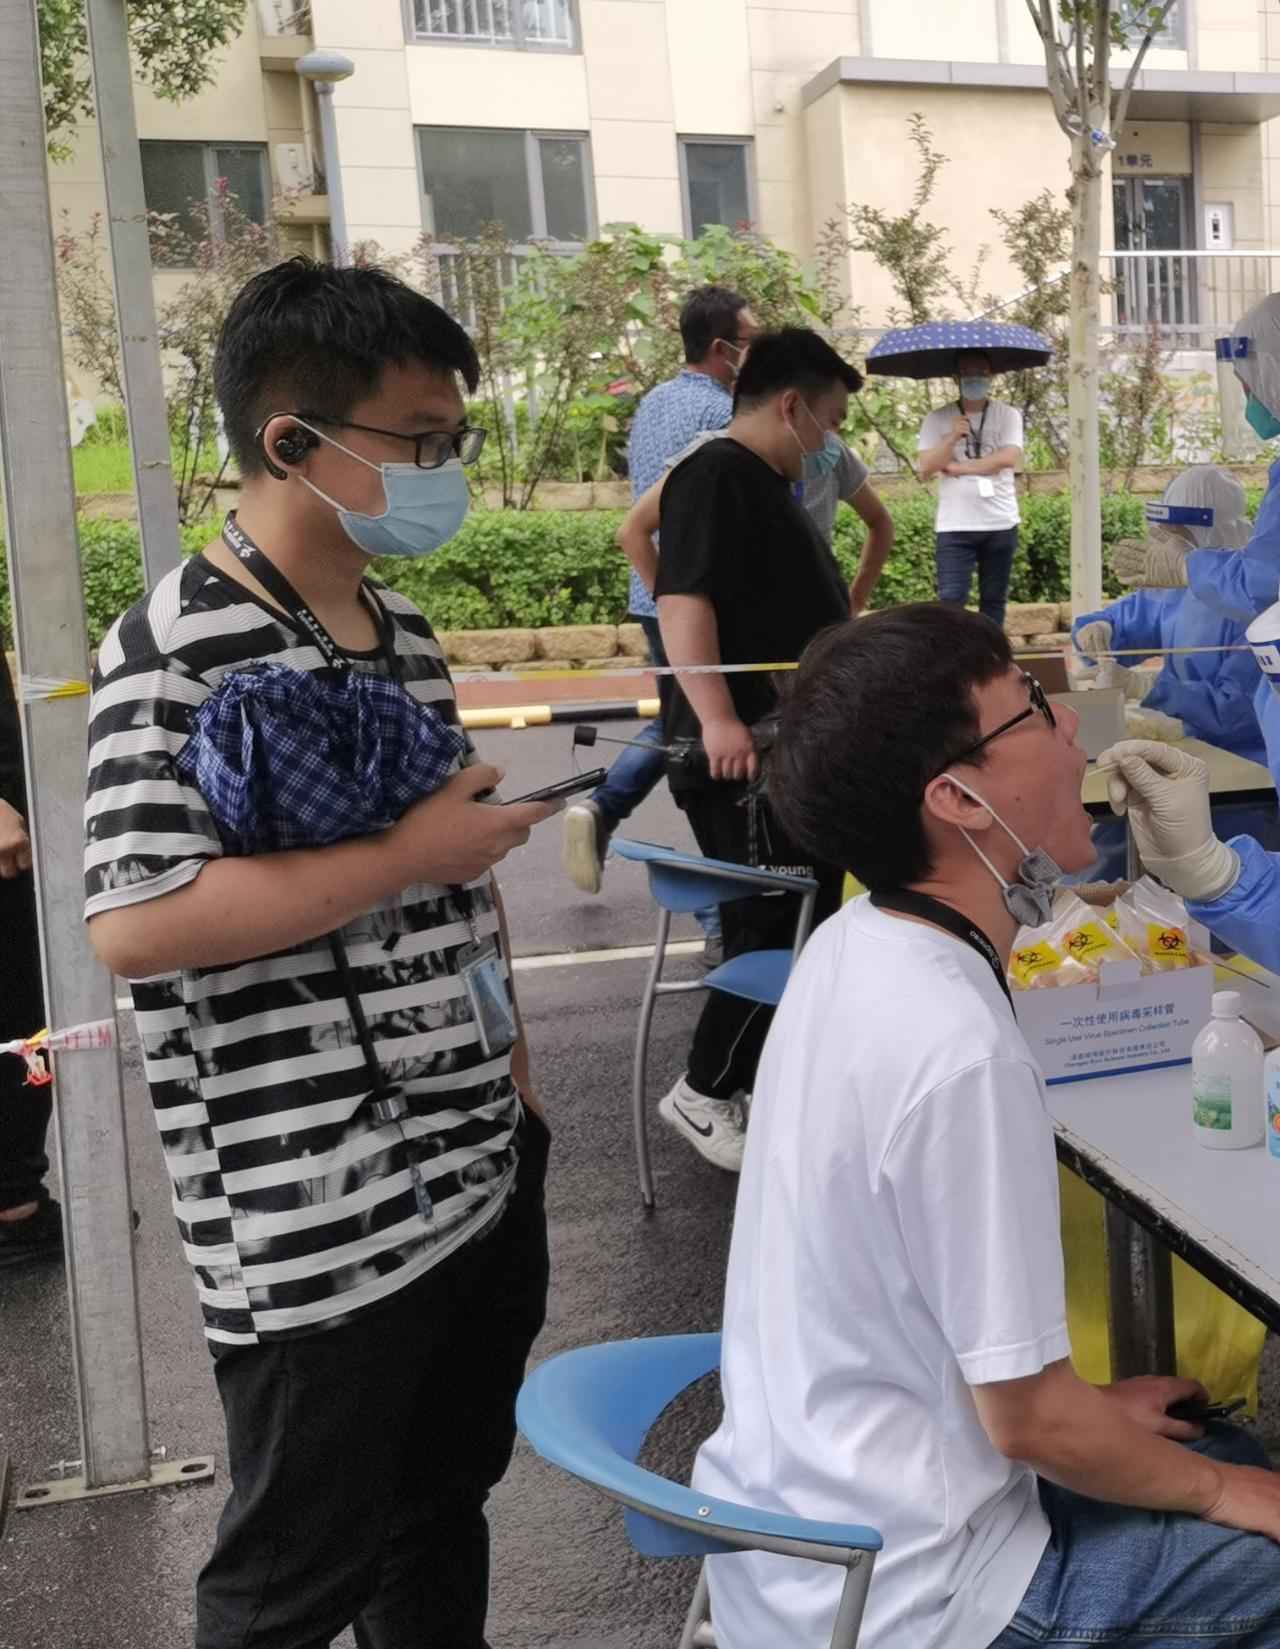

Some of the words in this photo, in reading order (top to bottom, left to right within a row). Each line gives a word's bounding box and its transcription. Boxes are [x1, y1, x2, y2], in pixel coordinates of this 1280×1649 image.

[1061, 1002, 1175, 1028] 一次性使用病毒采样管
[1045, 1037, 1067, 1046] Single
[1085, 1032, 1101, 1040] Virus
[1104, 1027, 1138, 1038] Specimen
[1139, 1022, 1172, 1032] Collection
